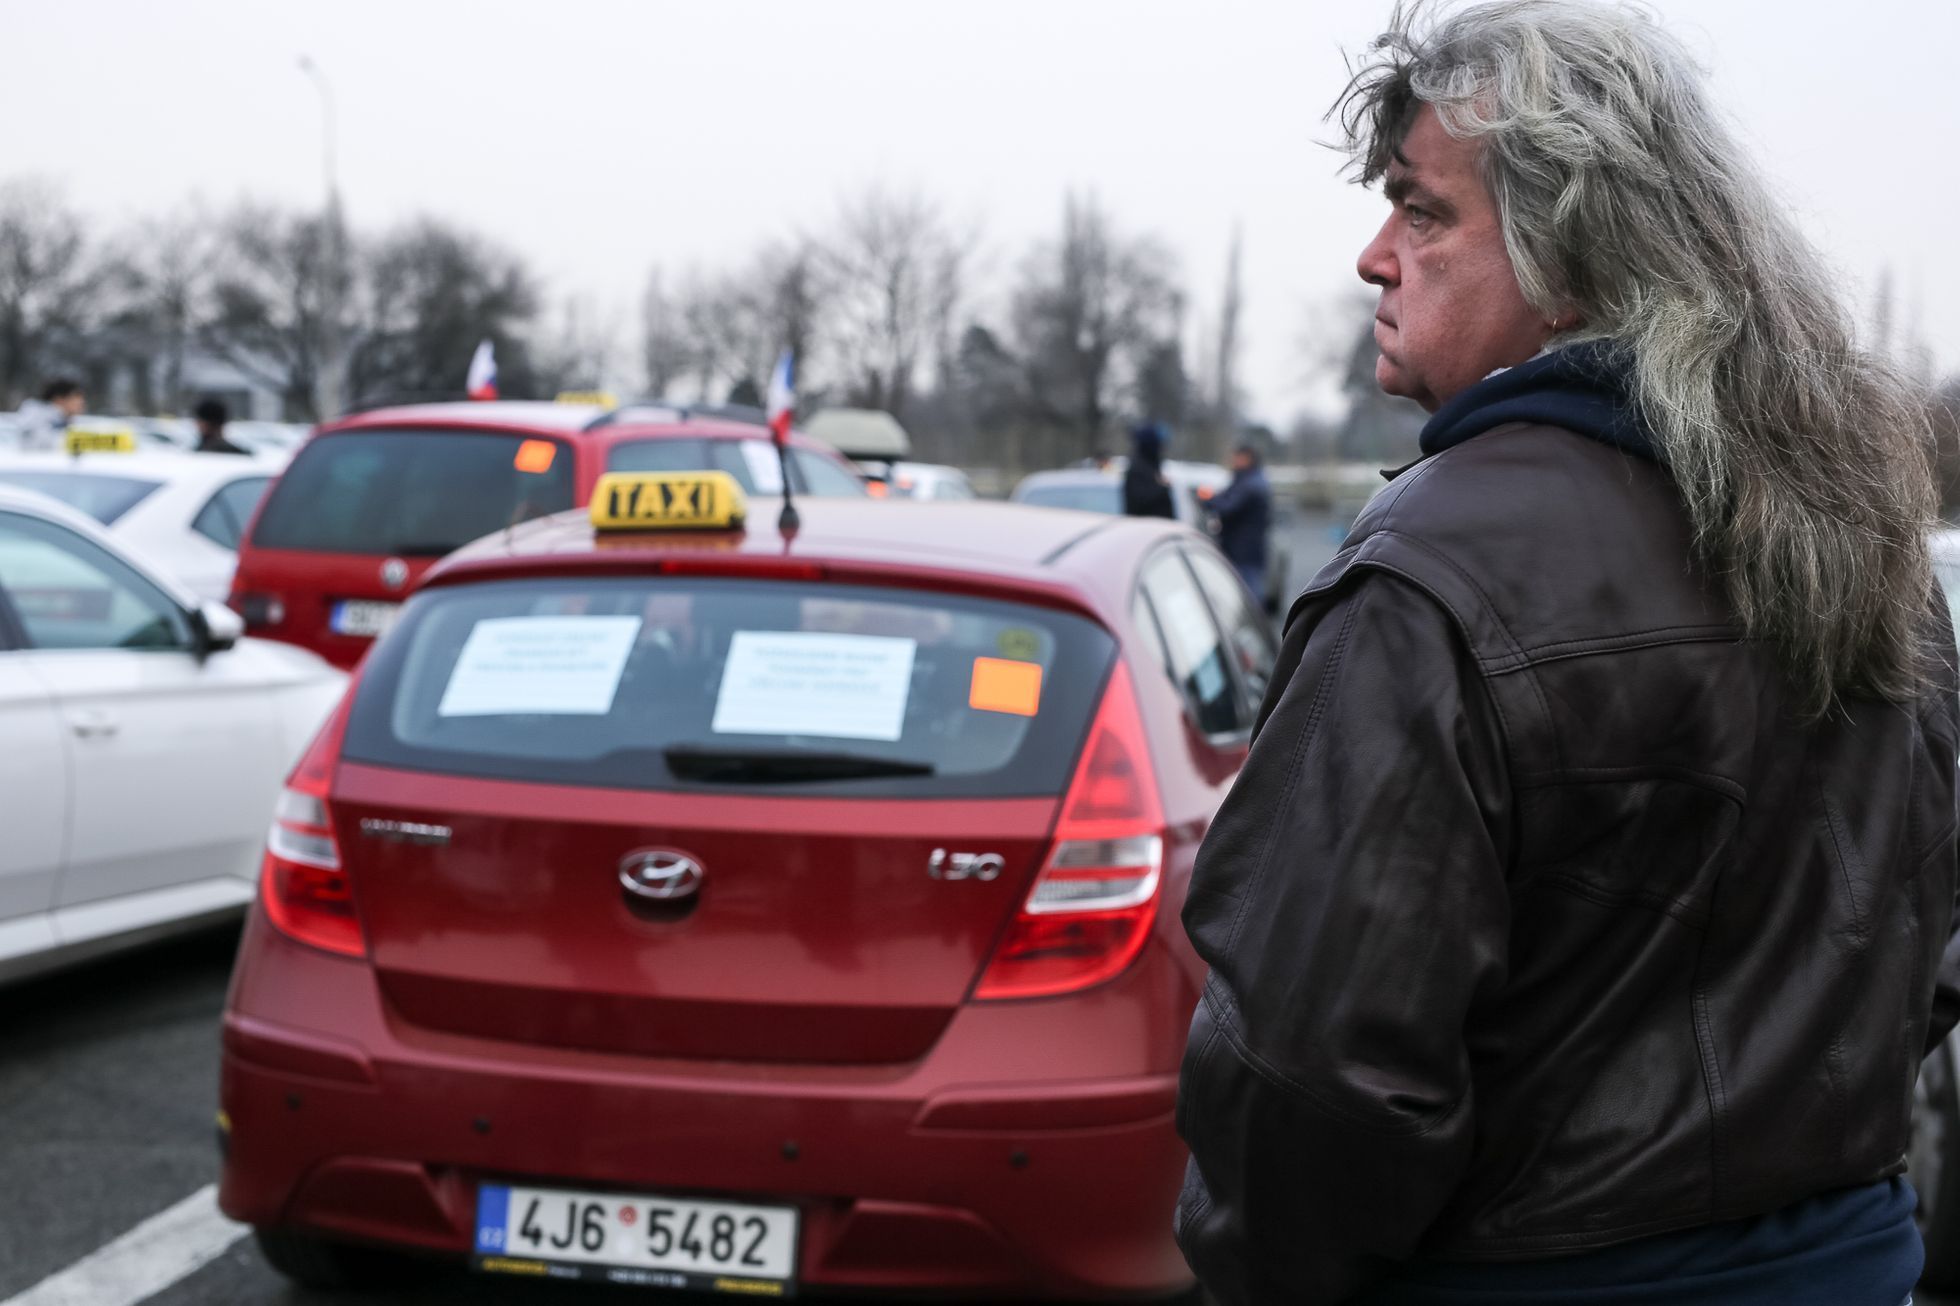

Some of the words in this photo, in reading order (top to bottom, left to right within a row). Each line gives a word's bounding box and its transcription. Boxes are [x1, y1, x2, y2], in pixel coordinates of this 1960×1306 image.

[608, 482, 716, 519] TAXI
[518, 1198, 607, 1252] 4J6
[646, 1208, 768, 1266] 5482
